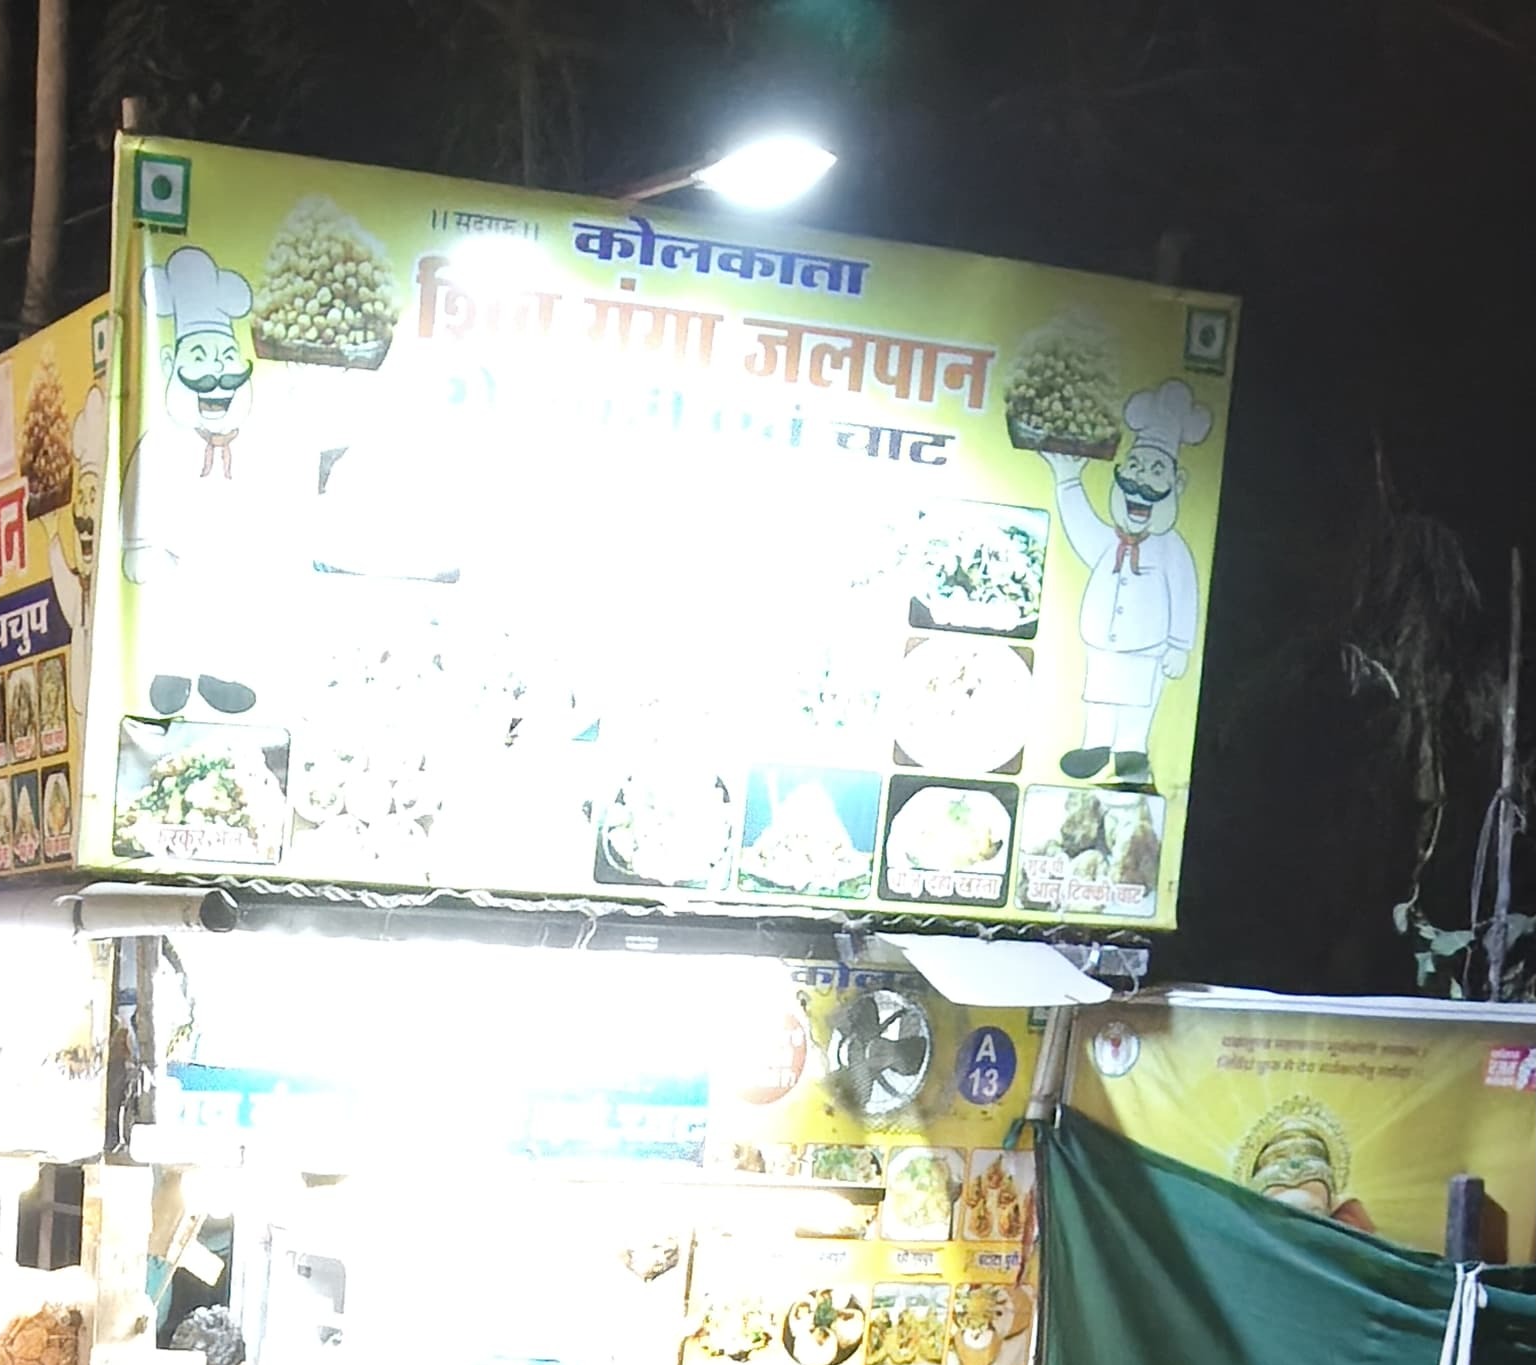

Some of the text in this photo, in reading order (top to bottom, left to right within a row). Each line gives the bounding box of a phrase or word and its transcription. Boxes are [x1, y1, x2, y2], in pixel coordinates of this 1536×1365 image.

[572, 216, 869, 295] कोलकाता
[743, 316, 996, 409] जलपान
[975, 1034, 998, 1062] A
[968, 1069, 999, 1098] 13
